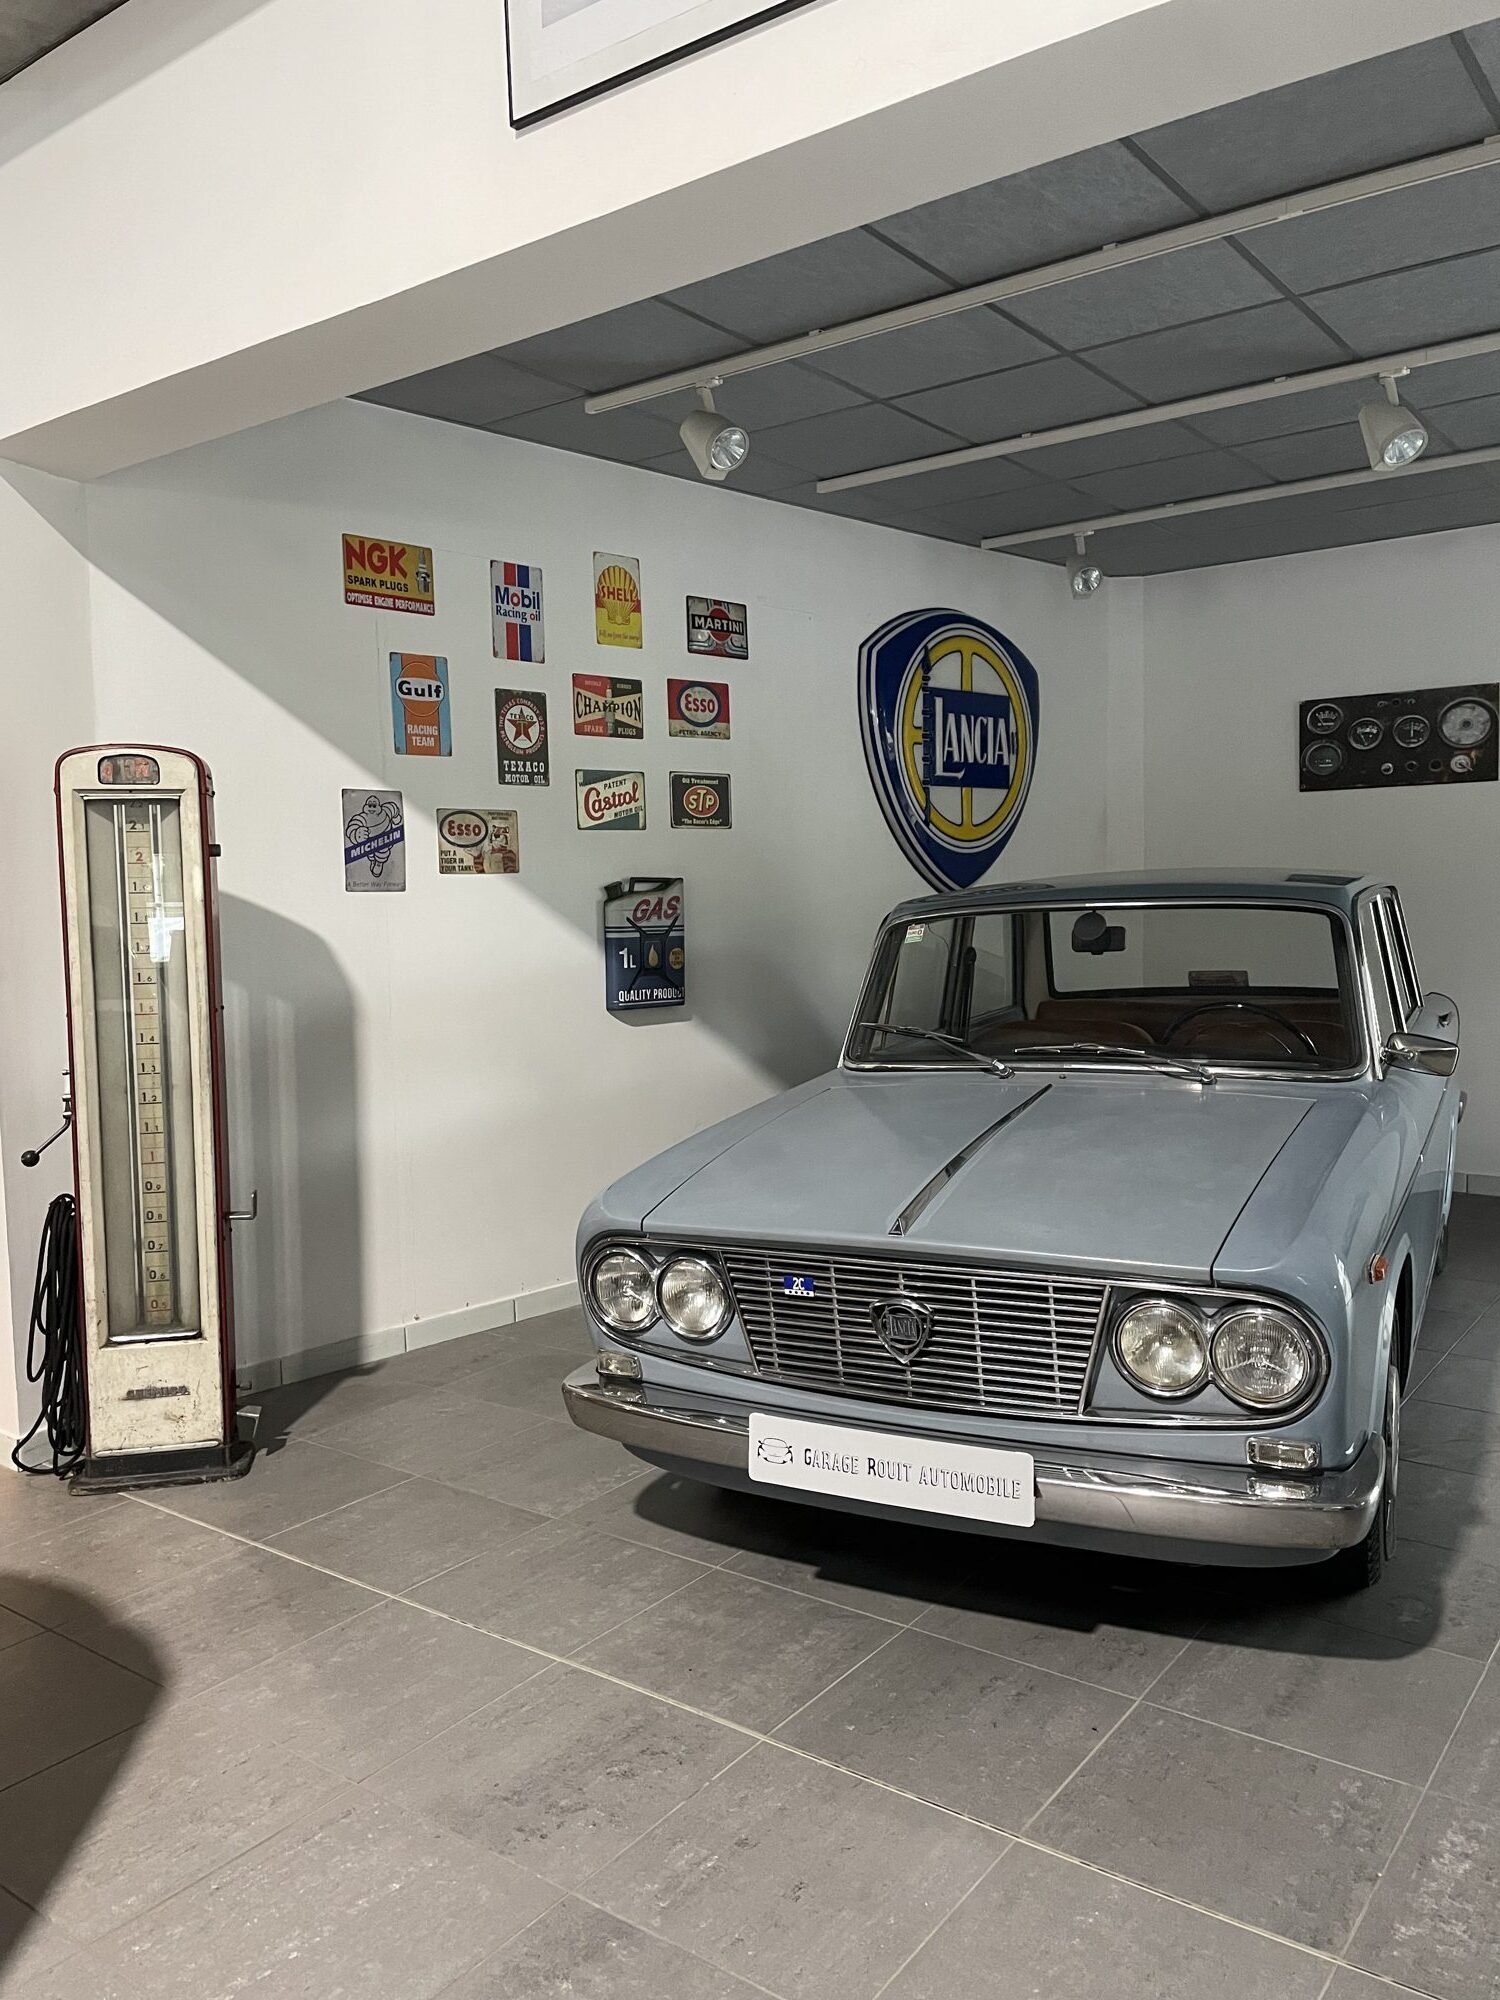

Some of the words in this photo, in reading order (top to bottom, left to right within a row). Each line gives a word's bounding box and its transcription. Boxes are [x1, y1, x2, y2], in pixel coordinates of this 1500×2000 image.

[345, 538, 408, 579] NGK
[347, 575, 377, 588] SPARK
[379, 580, 409, 592] PLUGS
[495, 585, 540, 610] Mobil
[601, 585, 636, 602] SHELL
[346, 592, 373, 604] OPTIMISE
[374, 596, 394, 607] ENGINE
[395, 599, 434, 613] PERFORMANCE
[496, 605, 528, 623] Racing
[529, 611, 541, 621] oil
[694, 616, 743, 633] MARTINI
[398, 680, 442, 698] Gulf
[501, 700, 514, 714] TEXAS
[516, 698, 540, 714] COMPANY
[576, 690, 641, 723] CHAMPION
[407, 724, 438, 735] RACING
[584, 725, 604, 733] SPARK
[618, 727, 637, 736] PLUGS
[412, 736, 435, 747] TEAM
[933, 696, 1010, 780] LANCIA
[503, 760, 545, 772] TEXACO
[505, 774, 530, 783] MOTOR
[534, 775, 545, 784] OIL
[603, 779, 627, 790] PATENT
[584, 781, 640, 821] Castrol
[689, 790, 715, 811] STP
[614, 807, 634, 818] MOTOR
[350, 830, 401, 858] MICHELIN
[135, 851, 143, 862] 2
[632, 895, 681, 924] GAS
[618, 947, 637, 969] 1L
[137, 972, 152, 982] 1.6
[618, 988, 652, 1002] QUALITY
[140, 1033, 154, 1042] 1.4
[141, 1063, 156, 1072] 1.3
[142, 1092, 157, 1102] 1.2
[145, 1181, 161, 1191] 0.9
[146, 1210, 163, 1220] 0.8
[149, 1270, 165, 1280] 0.6
[792, 1277, 805, 1290] 2C
[803, 1448, 859, 1475] GARAGE
[867, 1457, 912, 1482] ROUIT
[918, 1467, 1021, 1499] AUTOMOBILE
